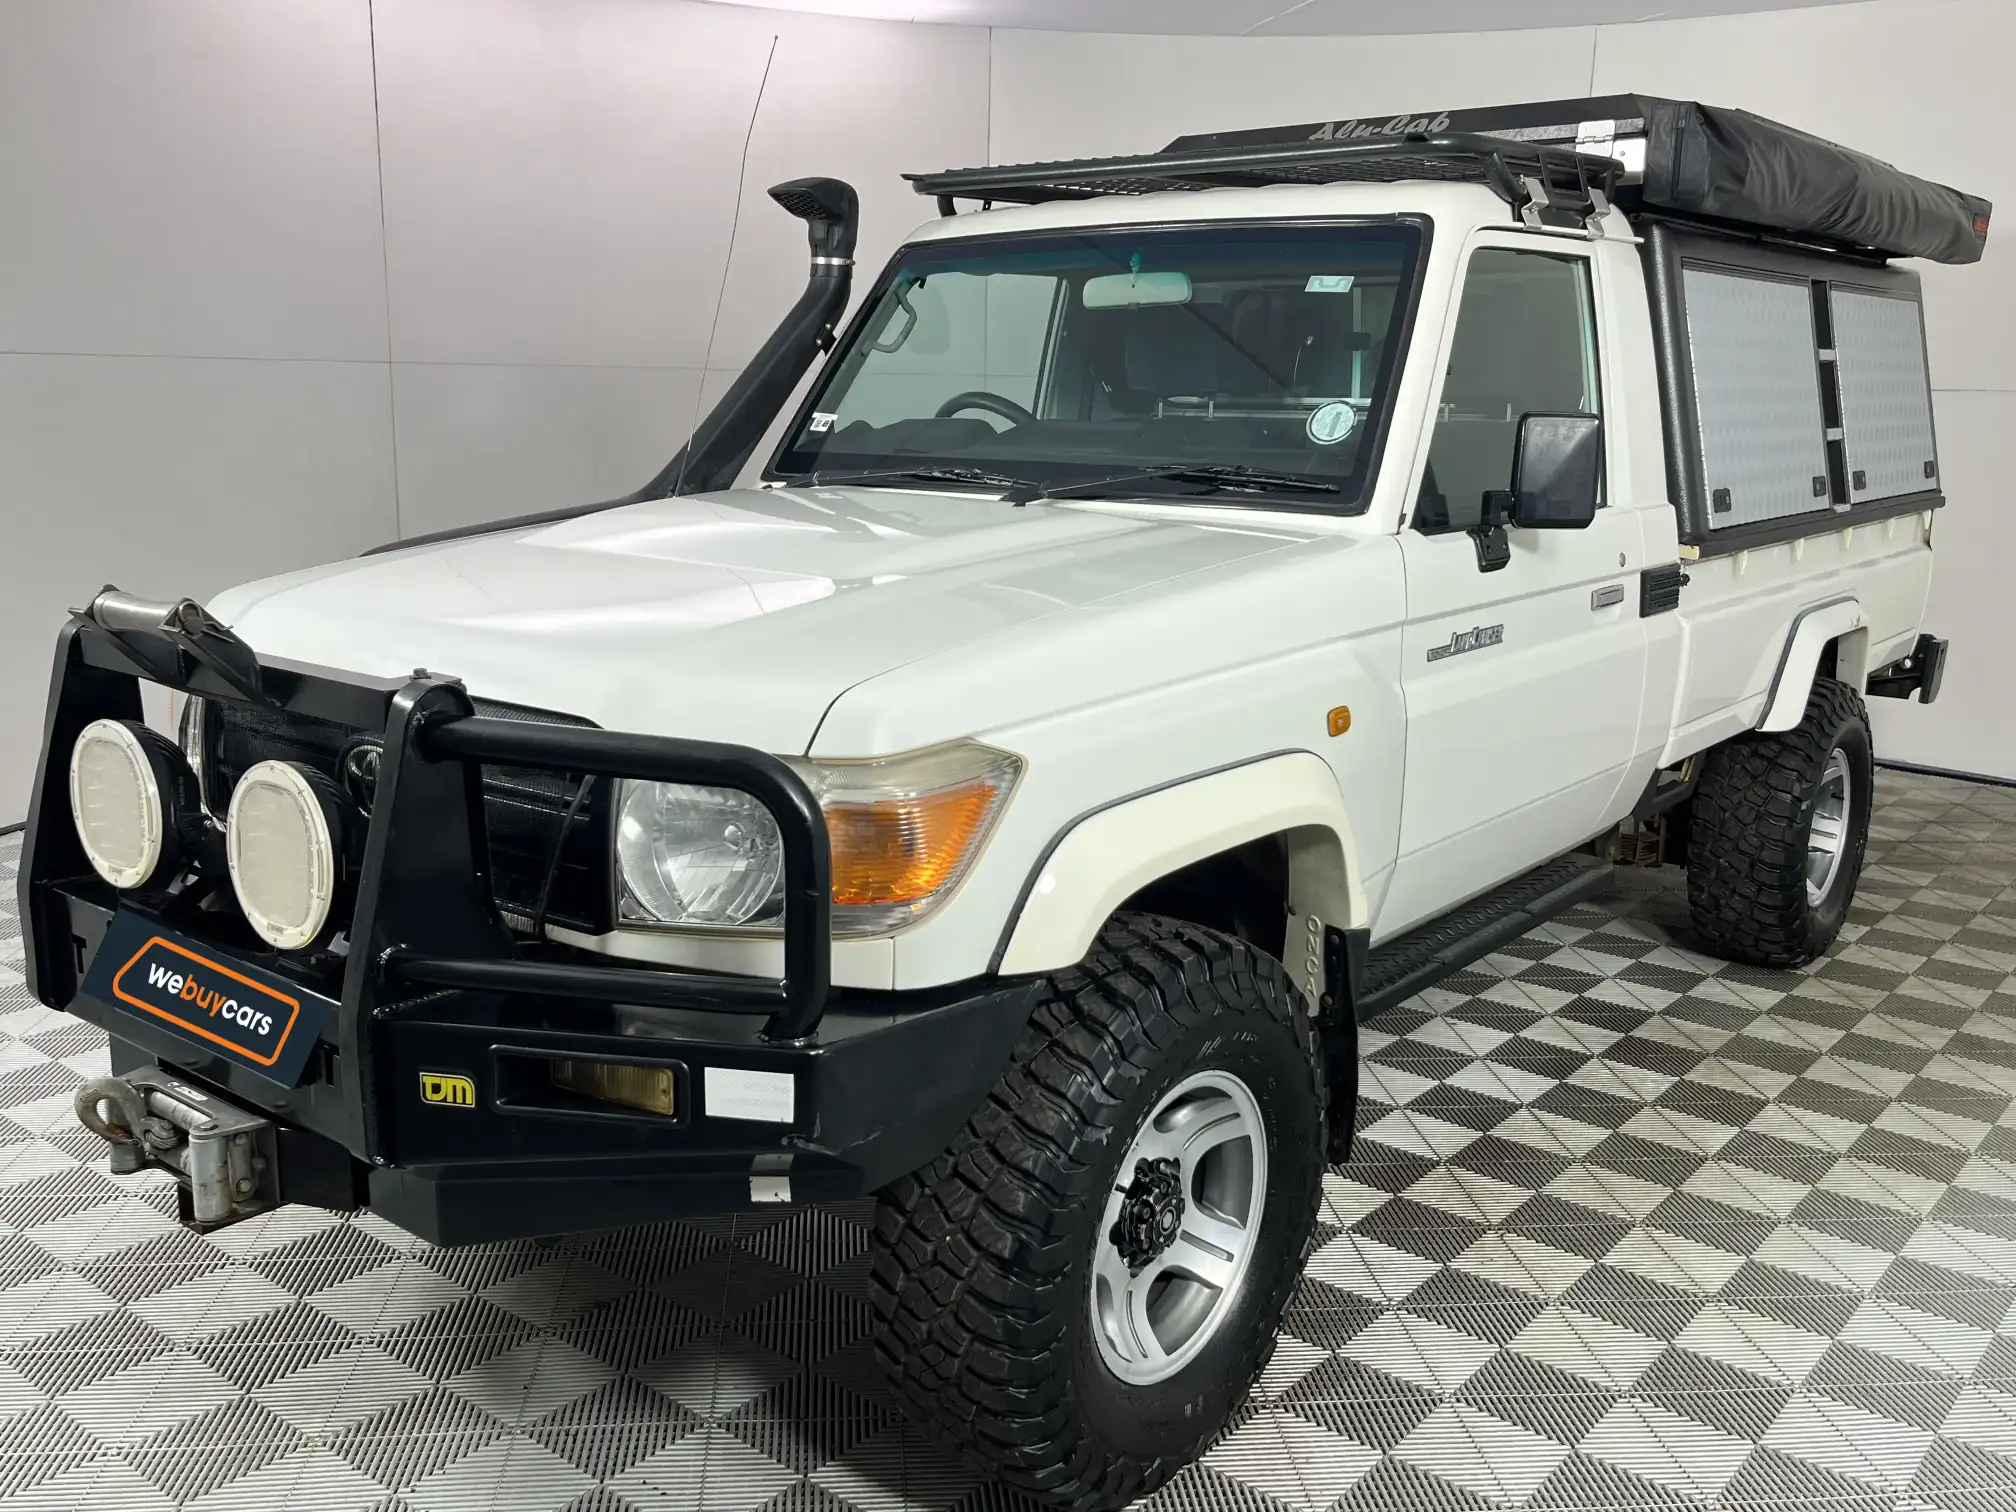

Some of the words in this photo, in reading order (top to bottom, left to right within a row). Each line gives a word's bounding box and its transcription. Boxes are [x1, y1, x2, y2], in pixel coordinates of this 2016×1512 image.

[1308, 112, 1450, 141] Alu-Cab
[1304, 914, 1321, 998] ONCA
[148, 963, 273, 1036] webuycars
